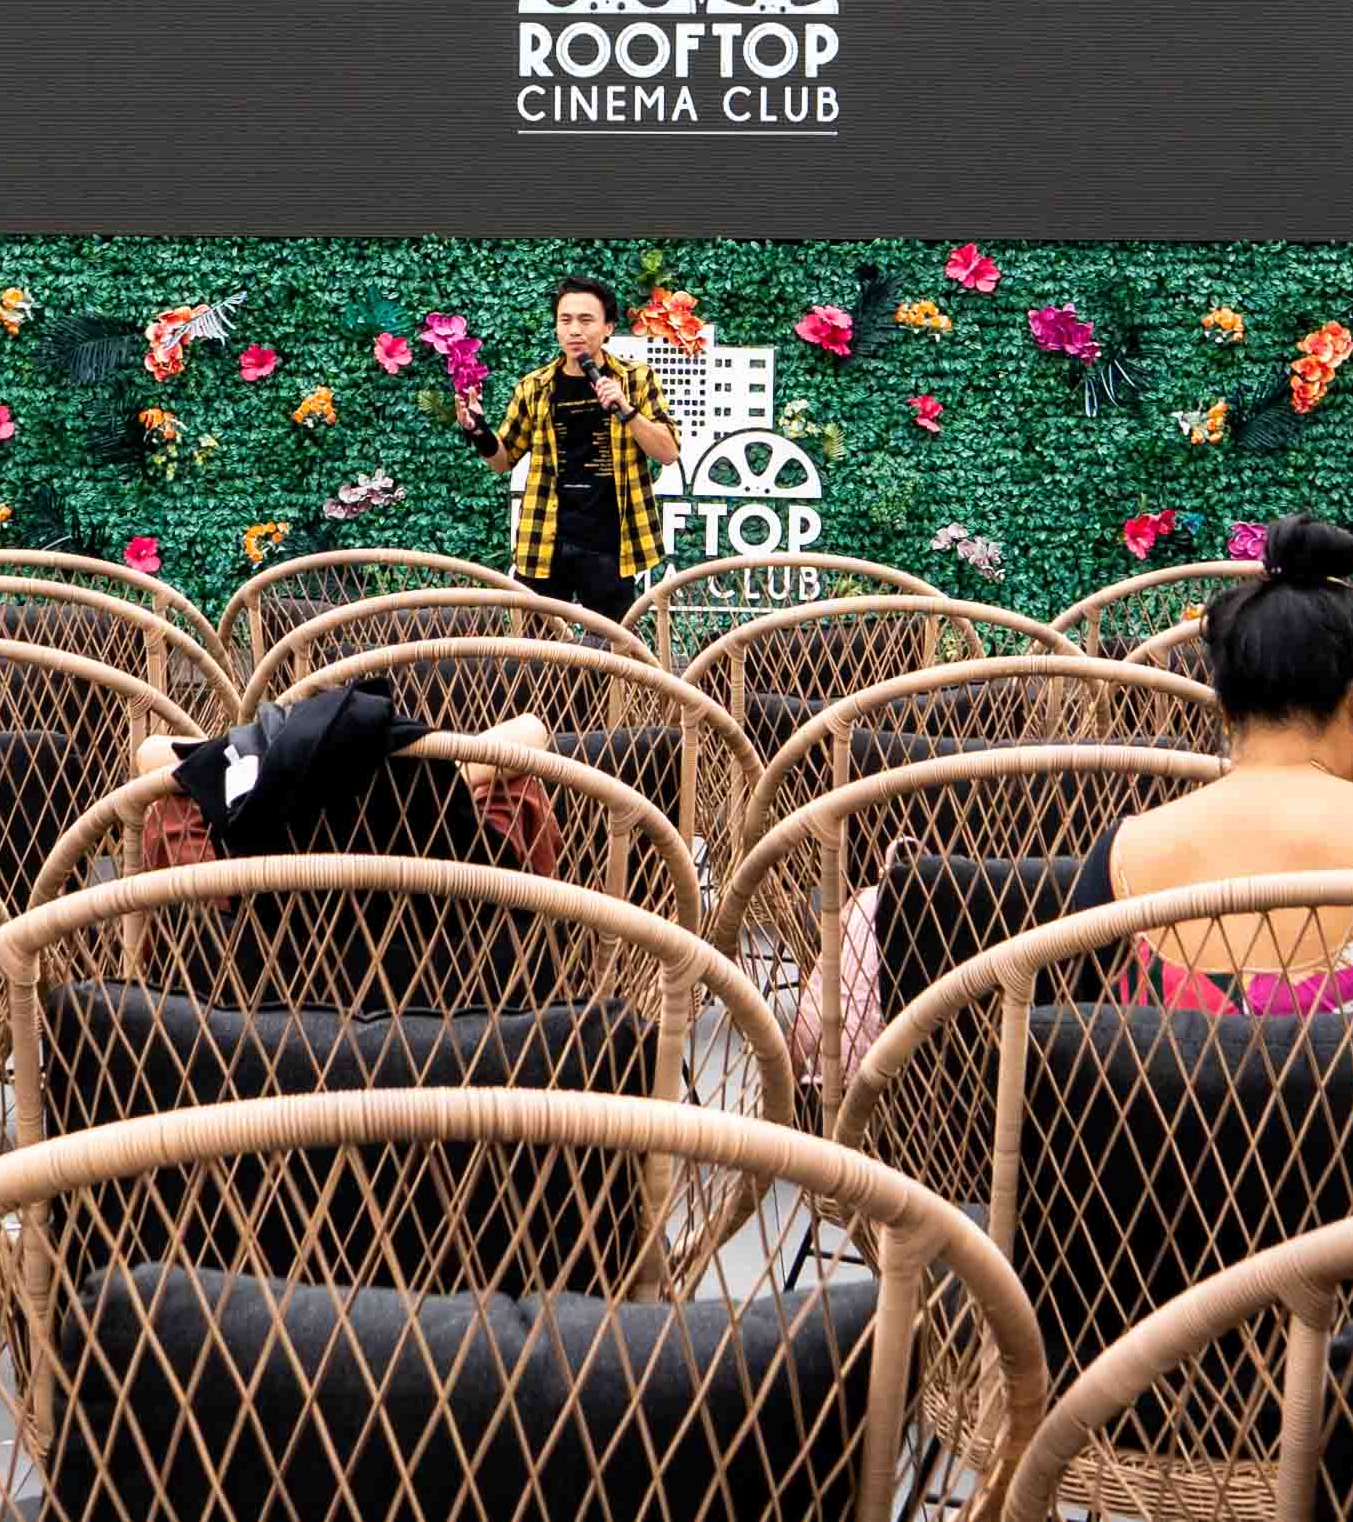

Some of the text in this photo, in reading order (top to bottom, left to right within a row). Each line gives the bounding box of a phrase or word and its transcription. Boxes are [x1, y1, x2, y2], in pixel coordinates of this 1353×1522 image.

[517, 21, 840, 79] ROOFTOP
[516, 84, 841, 123] CINEMA CLUB
